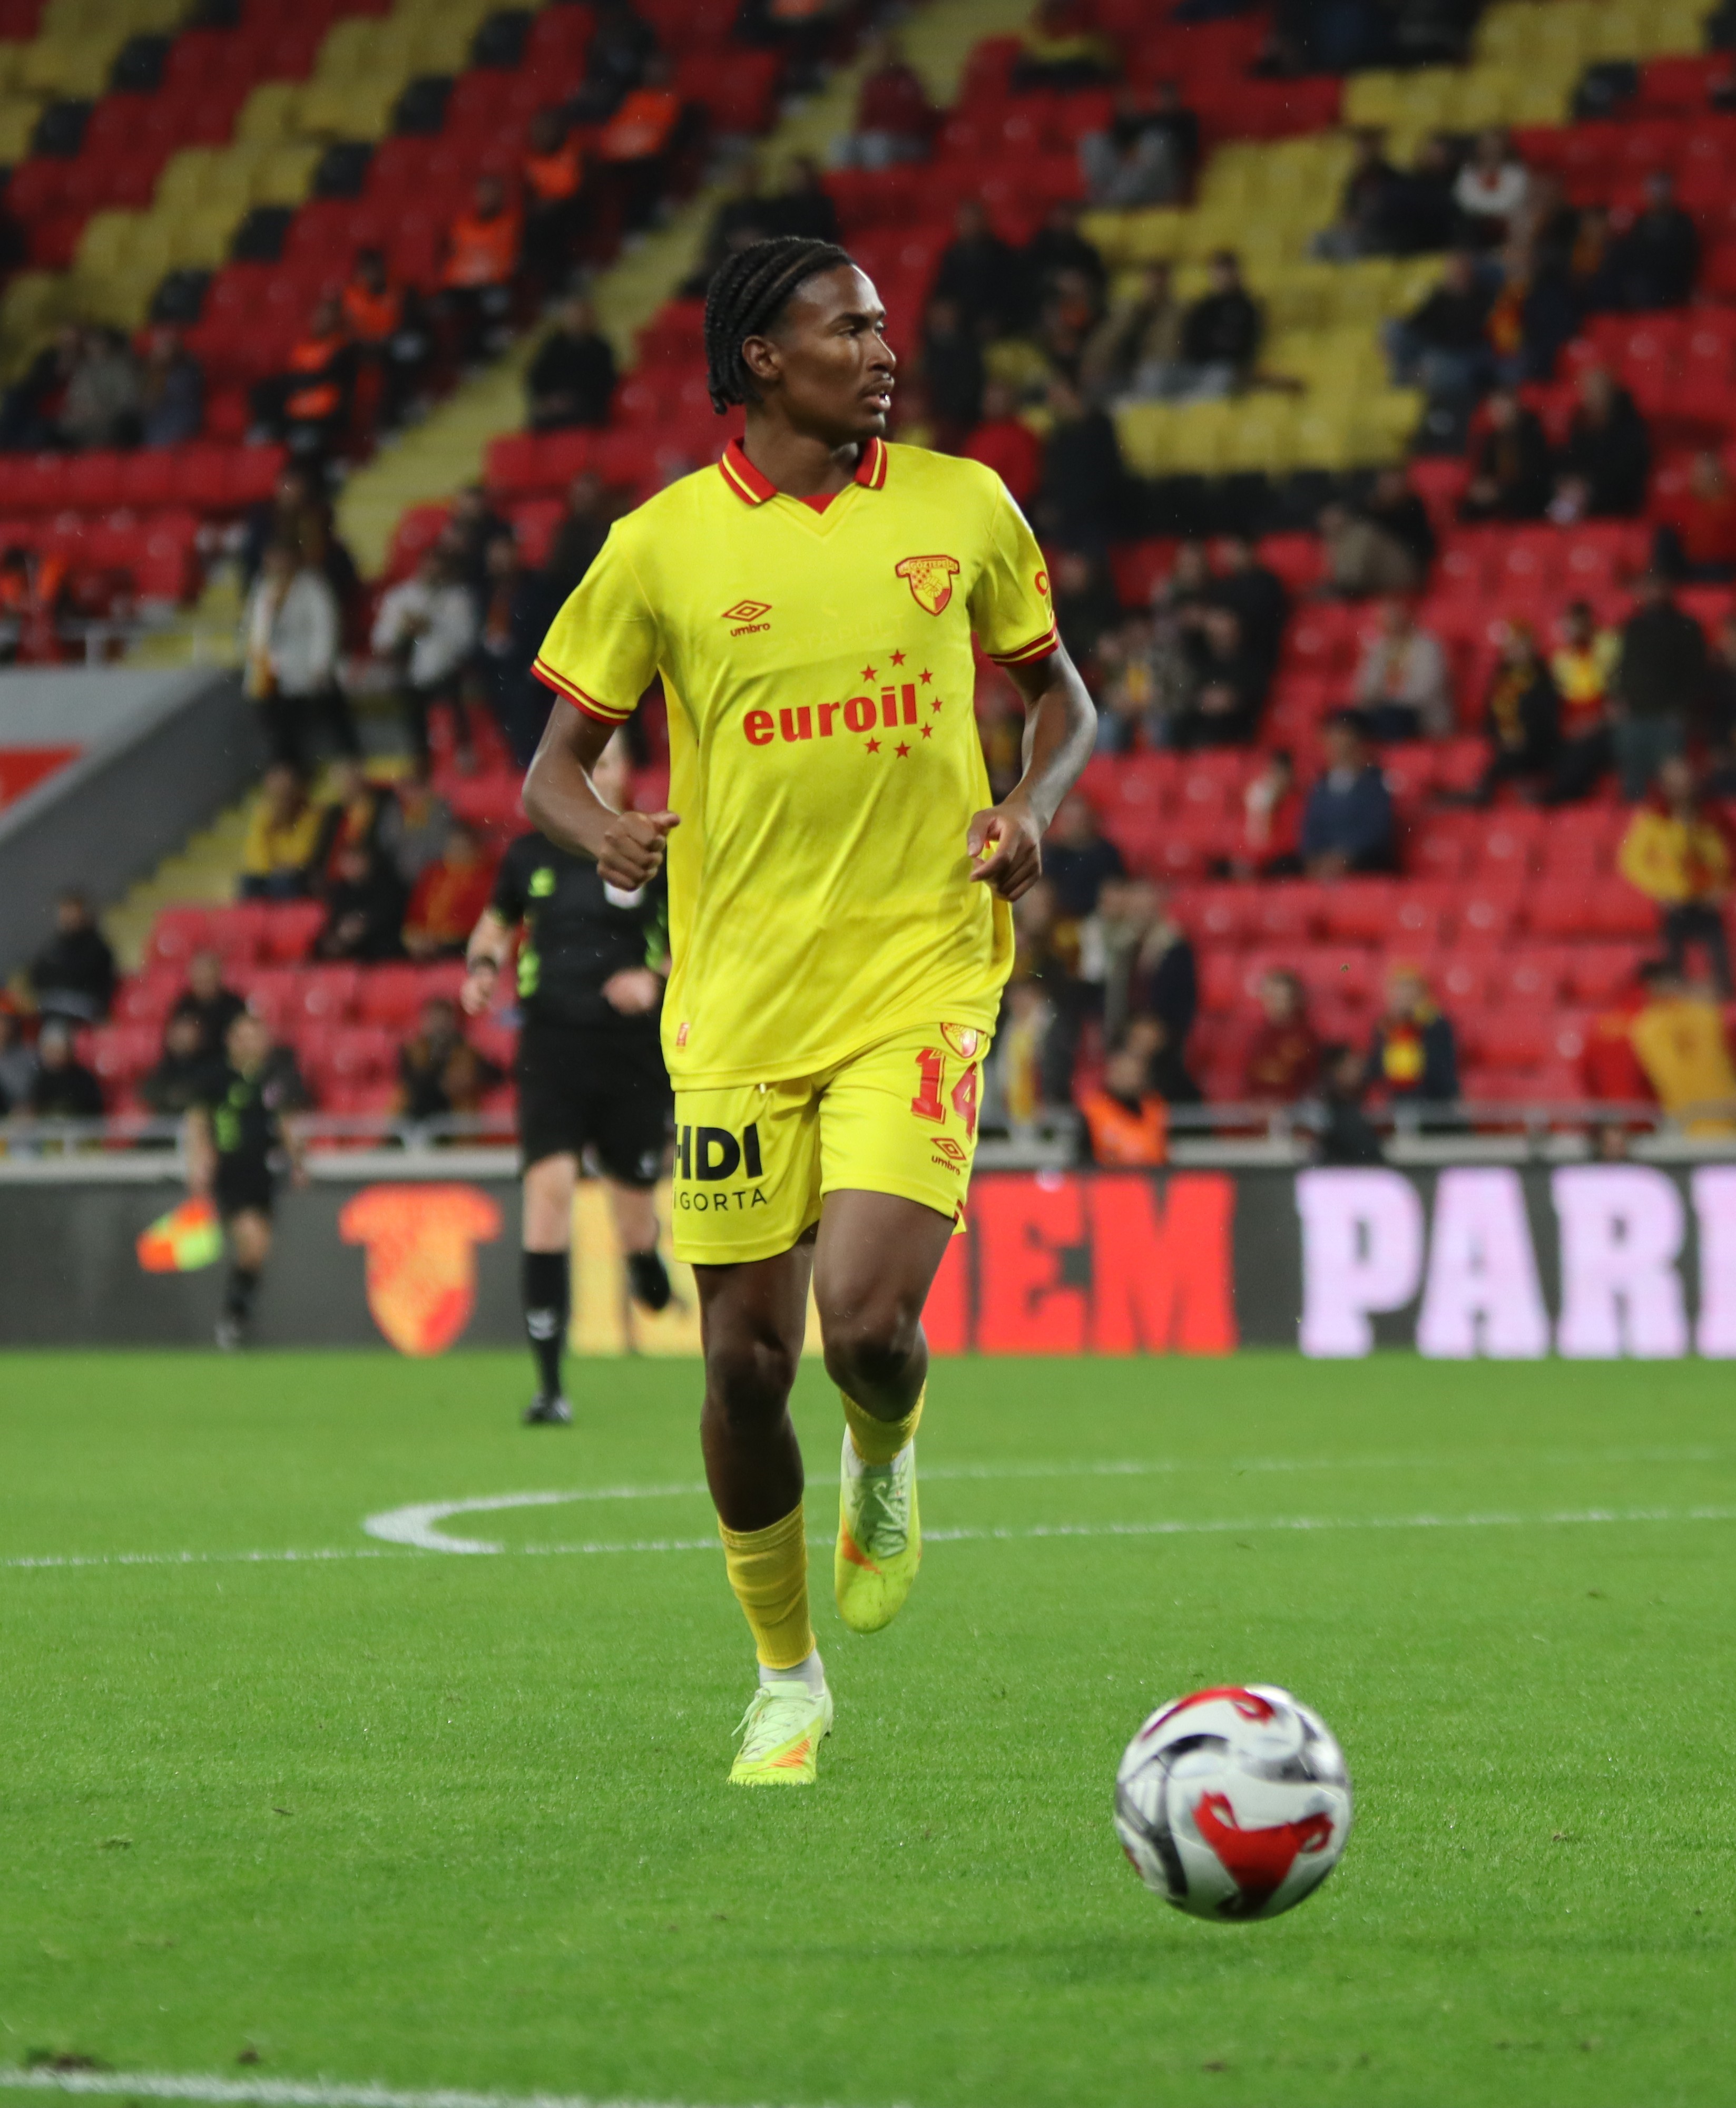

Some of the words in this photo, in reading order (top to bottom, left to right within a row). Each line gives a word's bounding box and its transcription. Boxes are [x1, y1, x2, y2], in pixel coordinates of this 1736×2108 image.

[730, 623, 770, 637] umbro
[743, 684, 917, 746] euroil
[910, 1047, 977, 1144] 14
[931, 1155, 960, 1176] umbro
